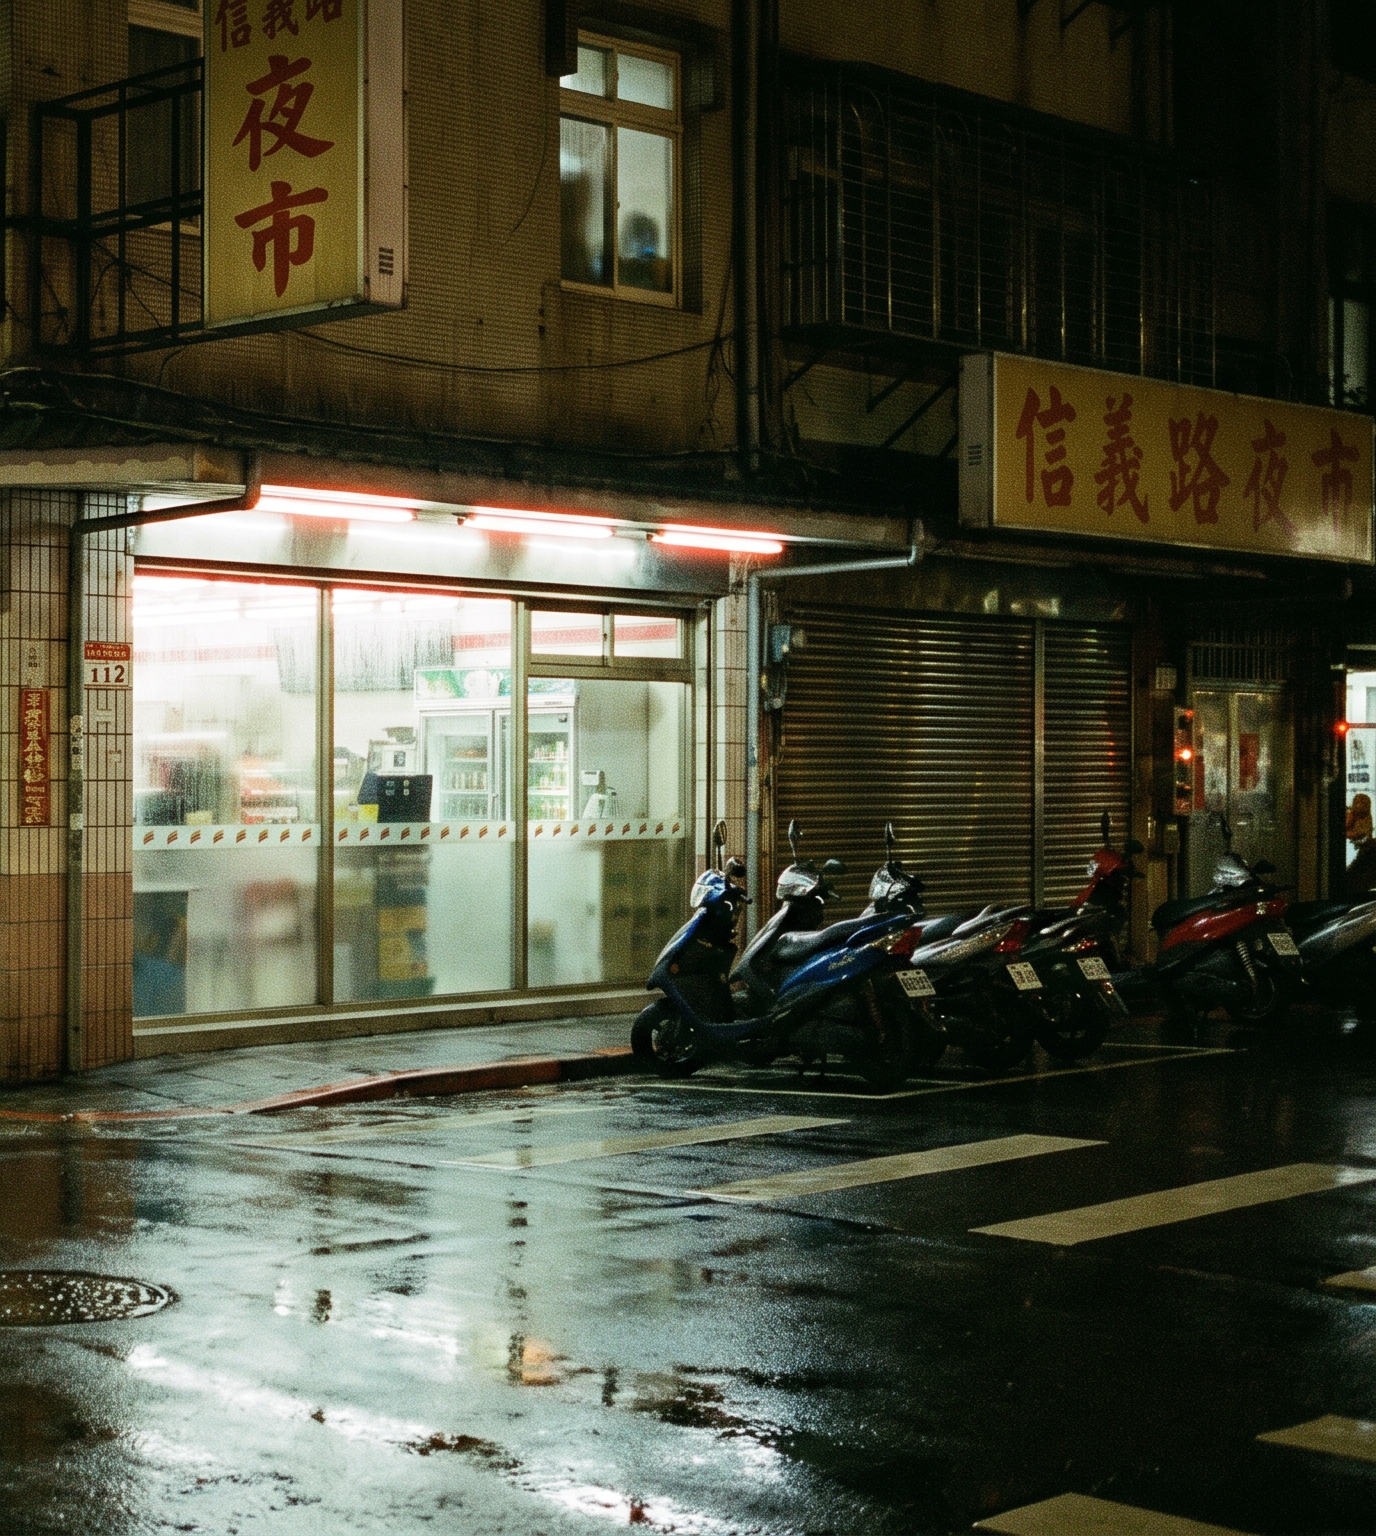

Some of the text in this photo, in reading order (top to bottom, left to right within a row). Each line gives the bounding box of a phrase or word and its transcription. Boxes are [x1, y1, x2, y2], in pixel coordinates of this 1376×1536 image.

[231, 54, 335, 298] 夜市
[1015, 384, 1362, 534] 信義路夜市
[91, 664, 125, 683] 112
